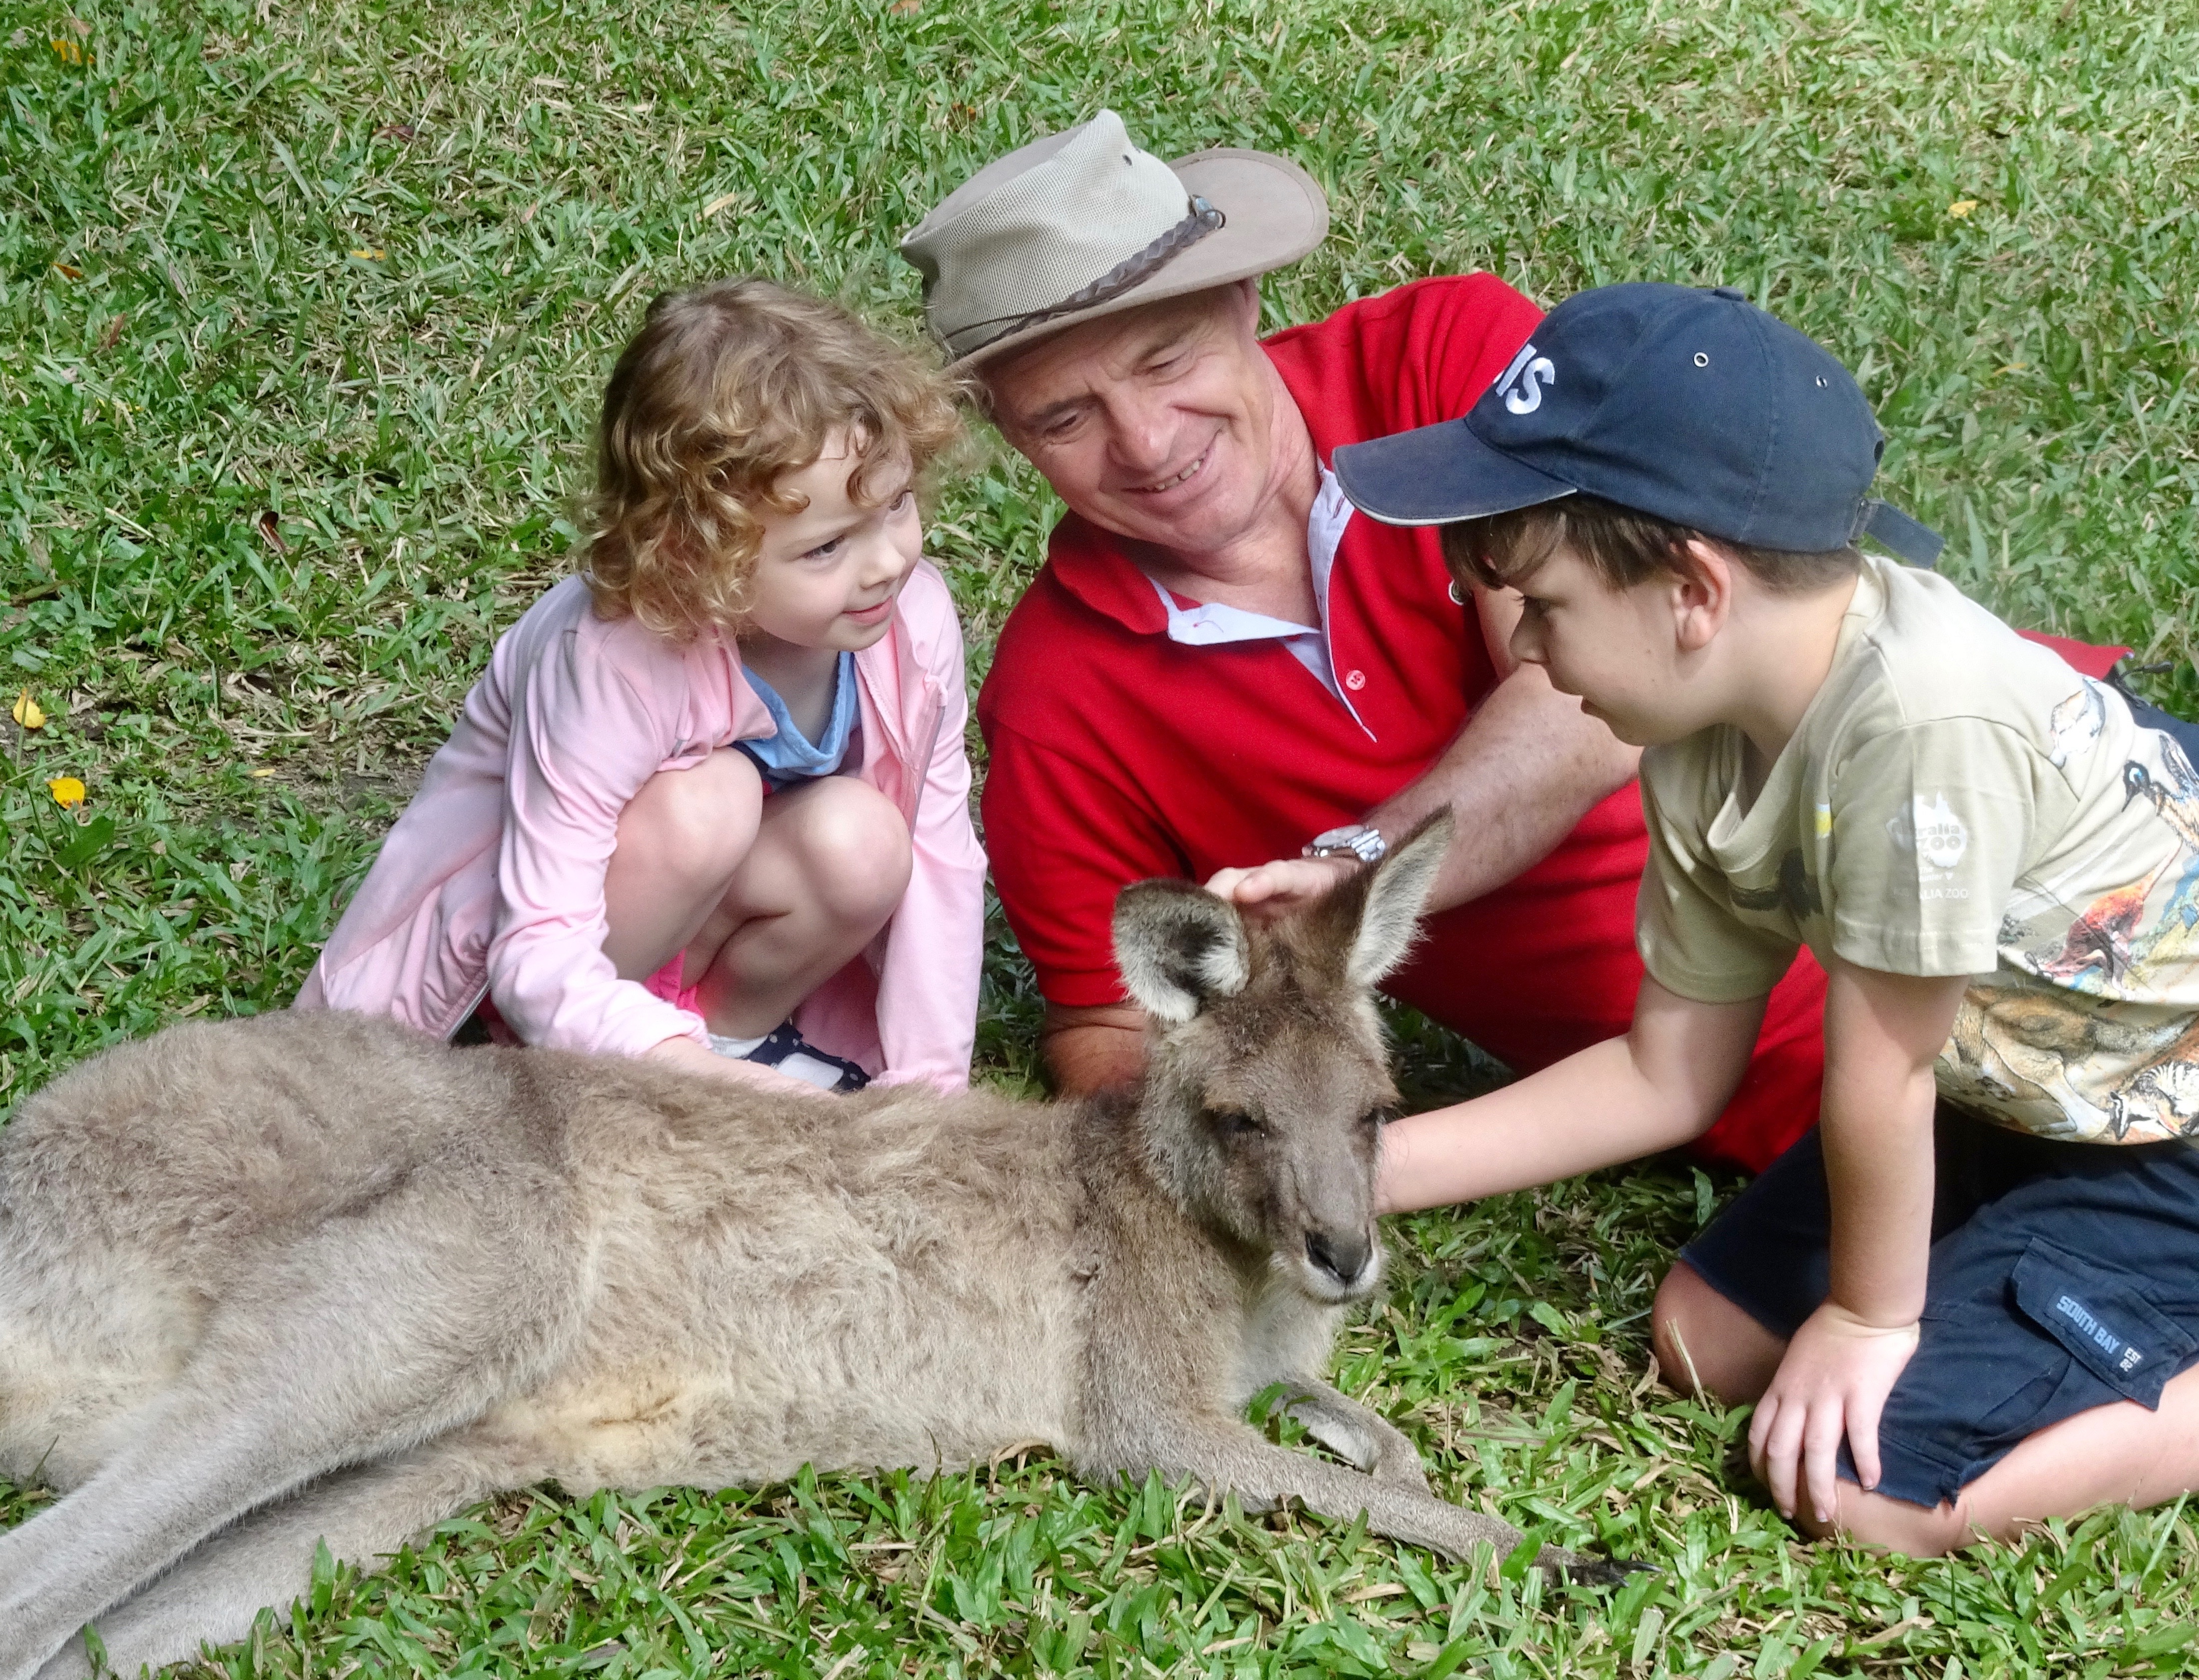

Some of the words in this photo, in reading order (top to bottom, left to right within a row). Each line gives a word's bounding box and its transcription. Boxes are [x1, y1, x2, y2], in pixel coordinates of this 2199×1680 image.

[1495, 343, 1555, 415] IS
[1945, 888, 1968, 899] ZOO
[2056, 1296, 2098, 1335] SOUTH
[2094, 1327, 2120, 1354] BAY
[2124, 1347, 2141, 1364] EST
